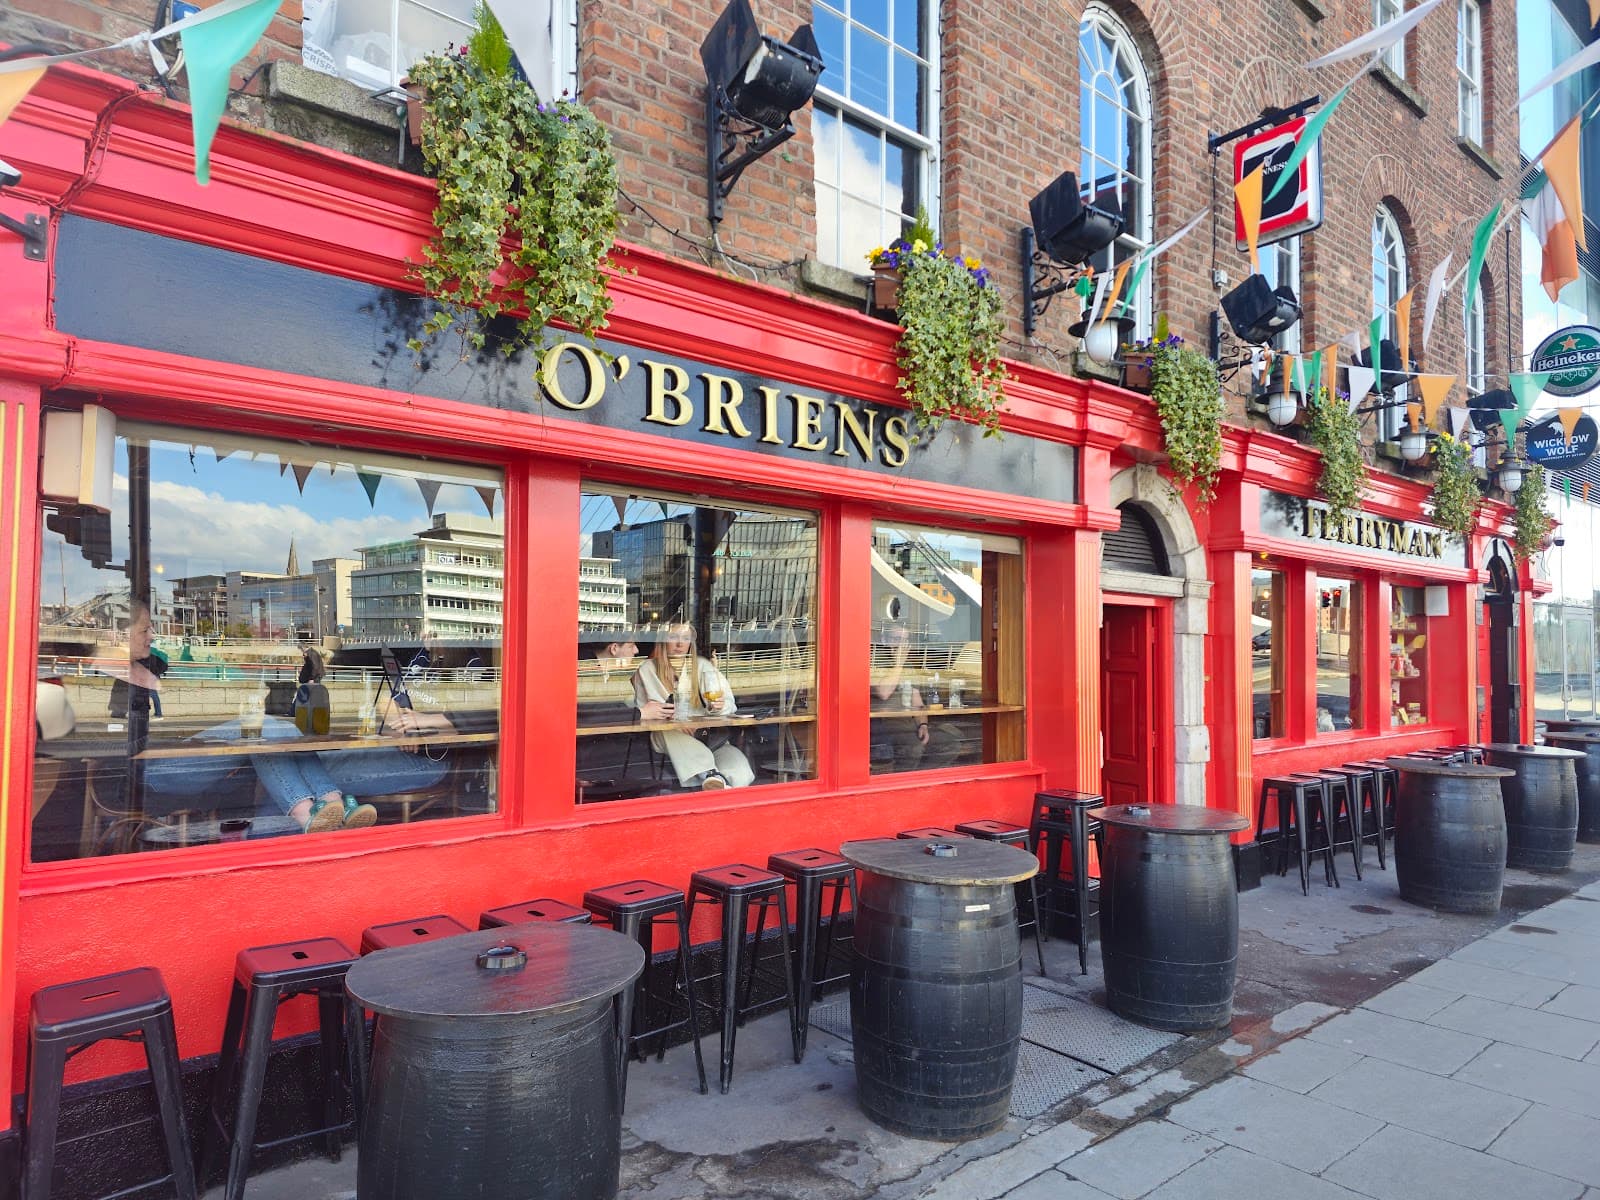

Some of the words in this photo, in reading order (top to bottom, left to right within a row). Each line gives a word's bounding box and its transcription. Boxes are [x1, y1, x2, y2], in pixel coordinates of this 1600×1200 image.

[303, 52, 337, 74] CRISPS
[539, 342, 910, 468] O'BRIENS
[1545, 445, 1579, 456] WOLF
[1303, 507, 1442, 558] FERRYMAN
